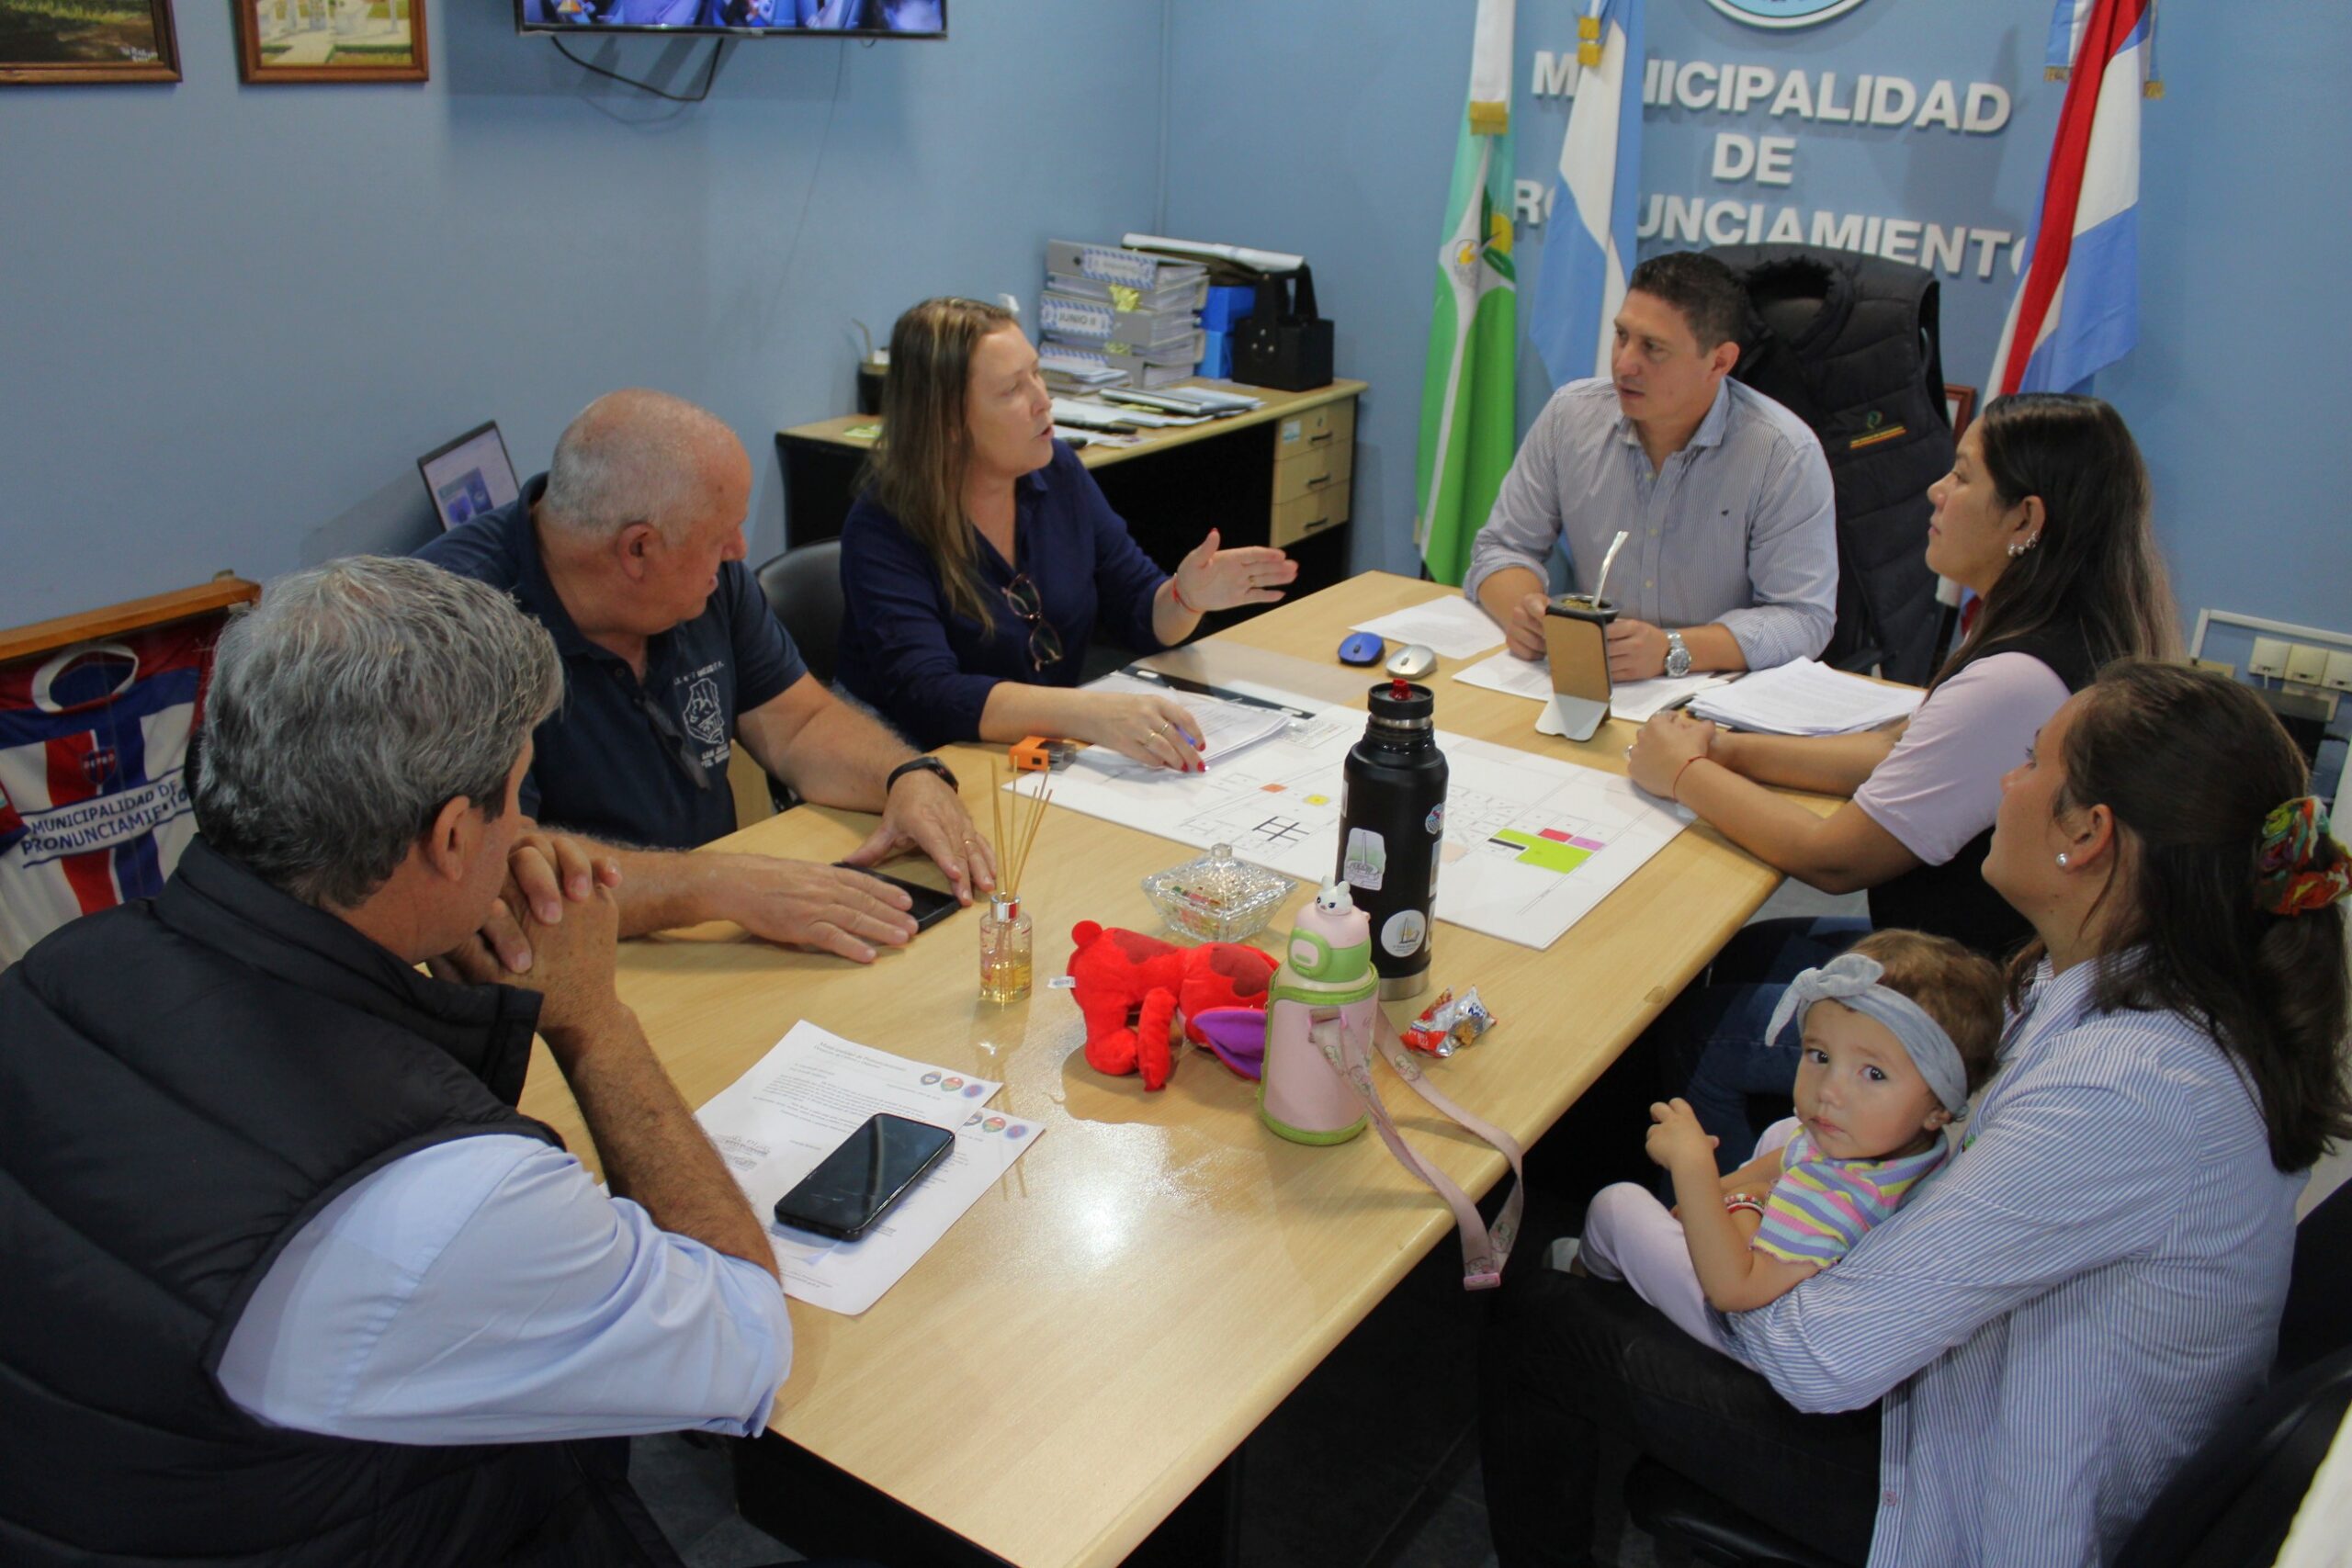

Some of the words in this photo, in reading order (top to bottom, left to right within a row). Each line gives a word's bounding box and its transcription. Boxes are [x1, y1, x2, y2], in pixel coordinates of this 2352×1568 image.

[1532, 51, 2011, 133] MICIPALIDAD
[1712, 132, 1796, 185] DE
[1514, 179, 2027, 277] RUNCIAMIENT
[20, 787, 188, 855] PRONUNCIAMIETO
[30, 790, 155, 835] MUNICIPALIDAD
